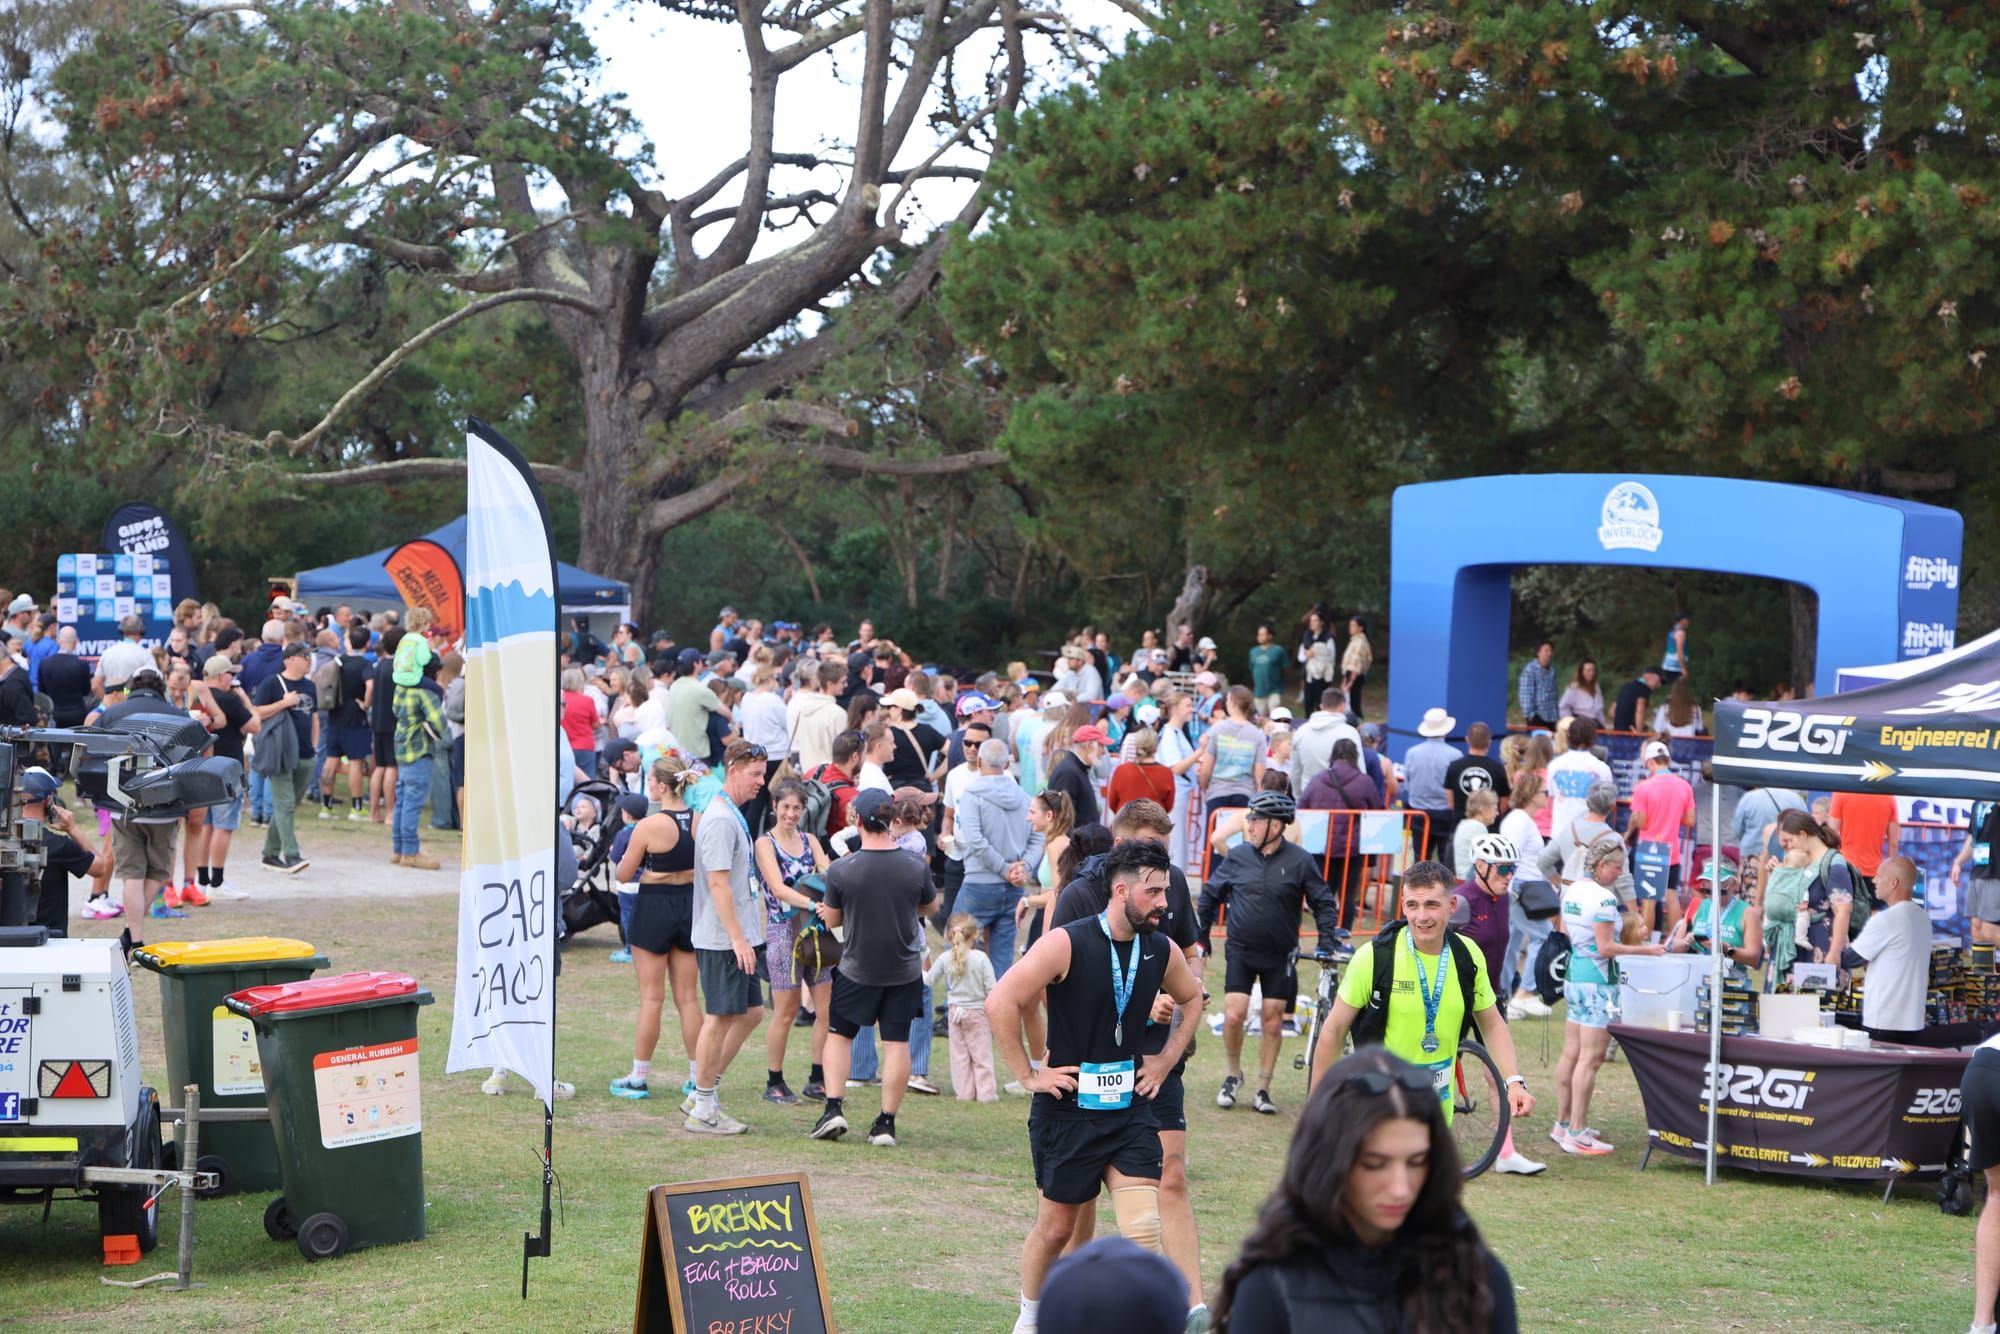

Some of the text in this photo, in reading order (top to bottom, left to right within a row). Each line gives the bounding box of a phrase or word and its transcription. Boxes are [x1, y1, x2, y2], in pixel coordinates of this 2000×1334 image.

[118, 516, 164, 538] GIPPS
[1602, 527, 1658, 541] INVERLOCH
[123, 536, 170, 555] LAND
[1905, 555, 1958, 589] fitcity
[421, 569, 449, 608] MEDAL
[73, 639, 161, 656] NVERCH
[1738, 709, 1857, 756] 32Gi
[1880, 726, 1991, 751] Engineered
[330, 1053, 367, 1064] GENERAL
[369, 1046, 403, 1058] RUBBISH
[1097, 1074, 1123, 1087] 1100
[1700, 1062, 1817, 1110] 32Gi
[1907, 1088, 1962, 1114] 32G
[1740, 1108, 1751, 1118] for
[1787, 1114, 1815, 1127] energy
[1731, 1144, 1790, 1163] ACCELERATE
[1832, 1155, 1881, 1168] RECOVER
[687, 1195, 793, 1235] BREKKY
[683, 1260, 721, 1284] EGG
[740, 1254, 799, 1276] BACON
[724, 1278, 777, 1301] ROLLS
[708, 1309, 792, 1334] BREKKY
